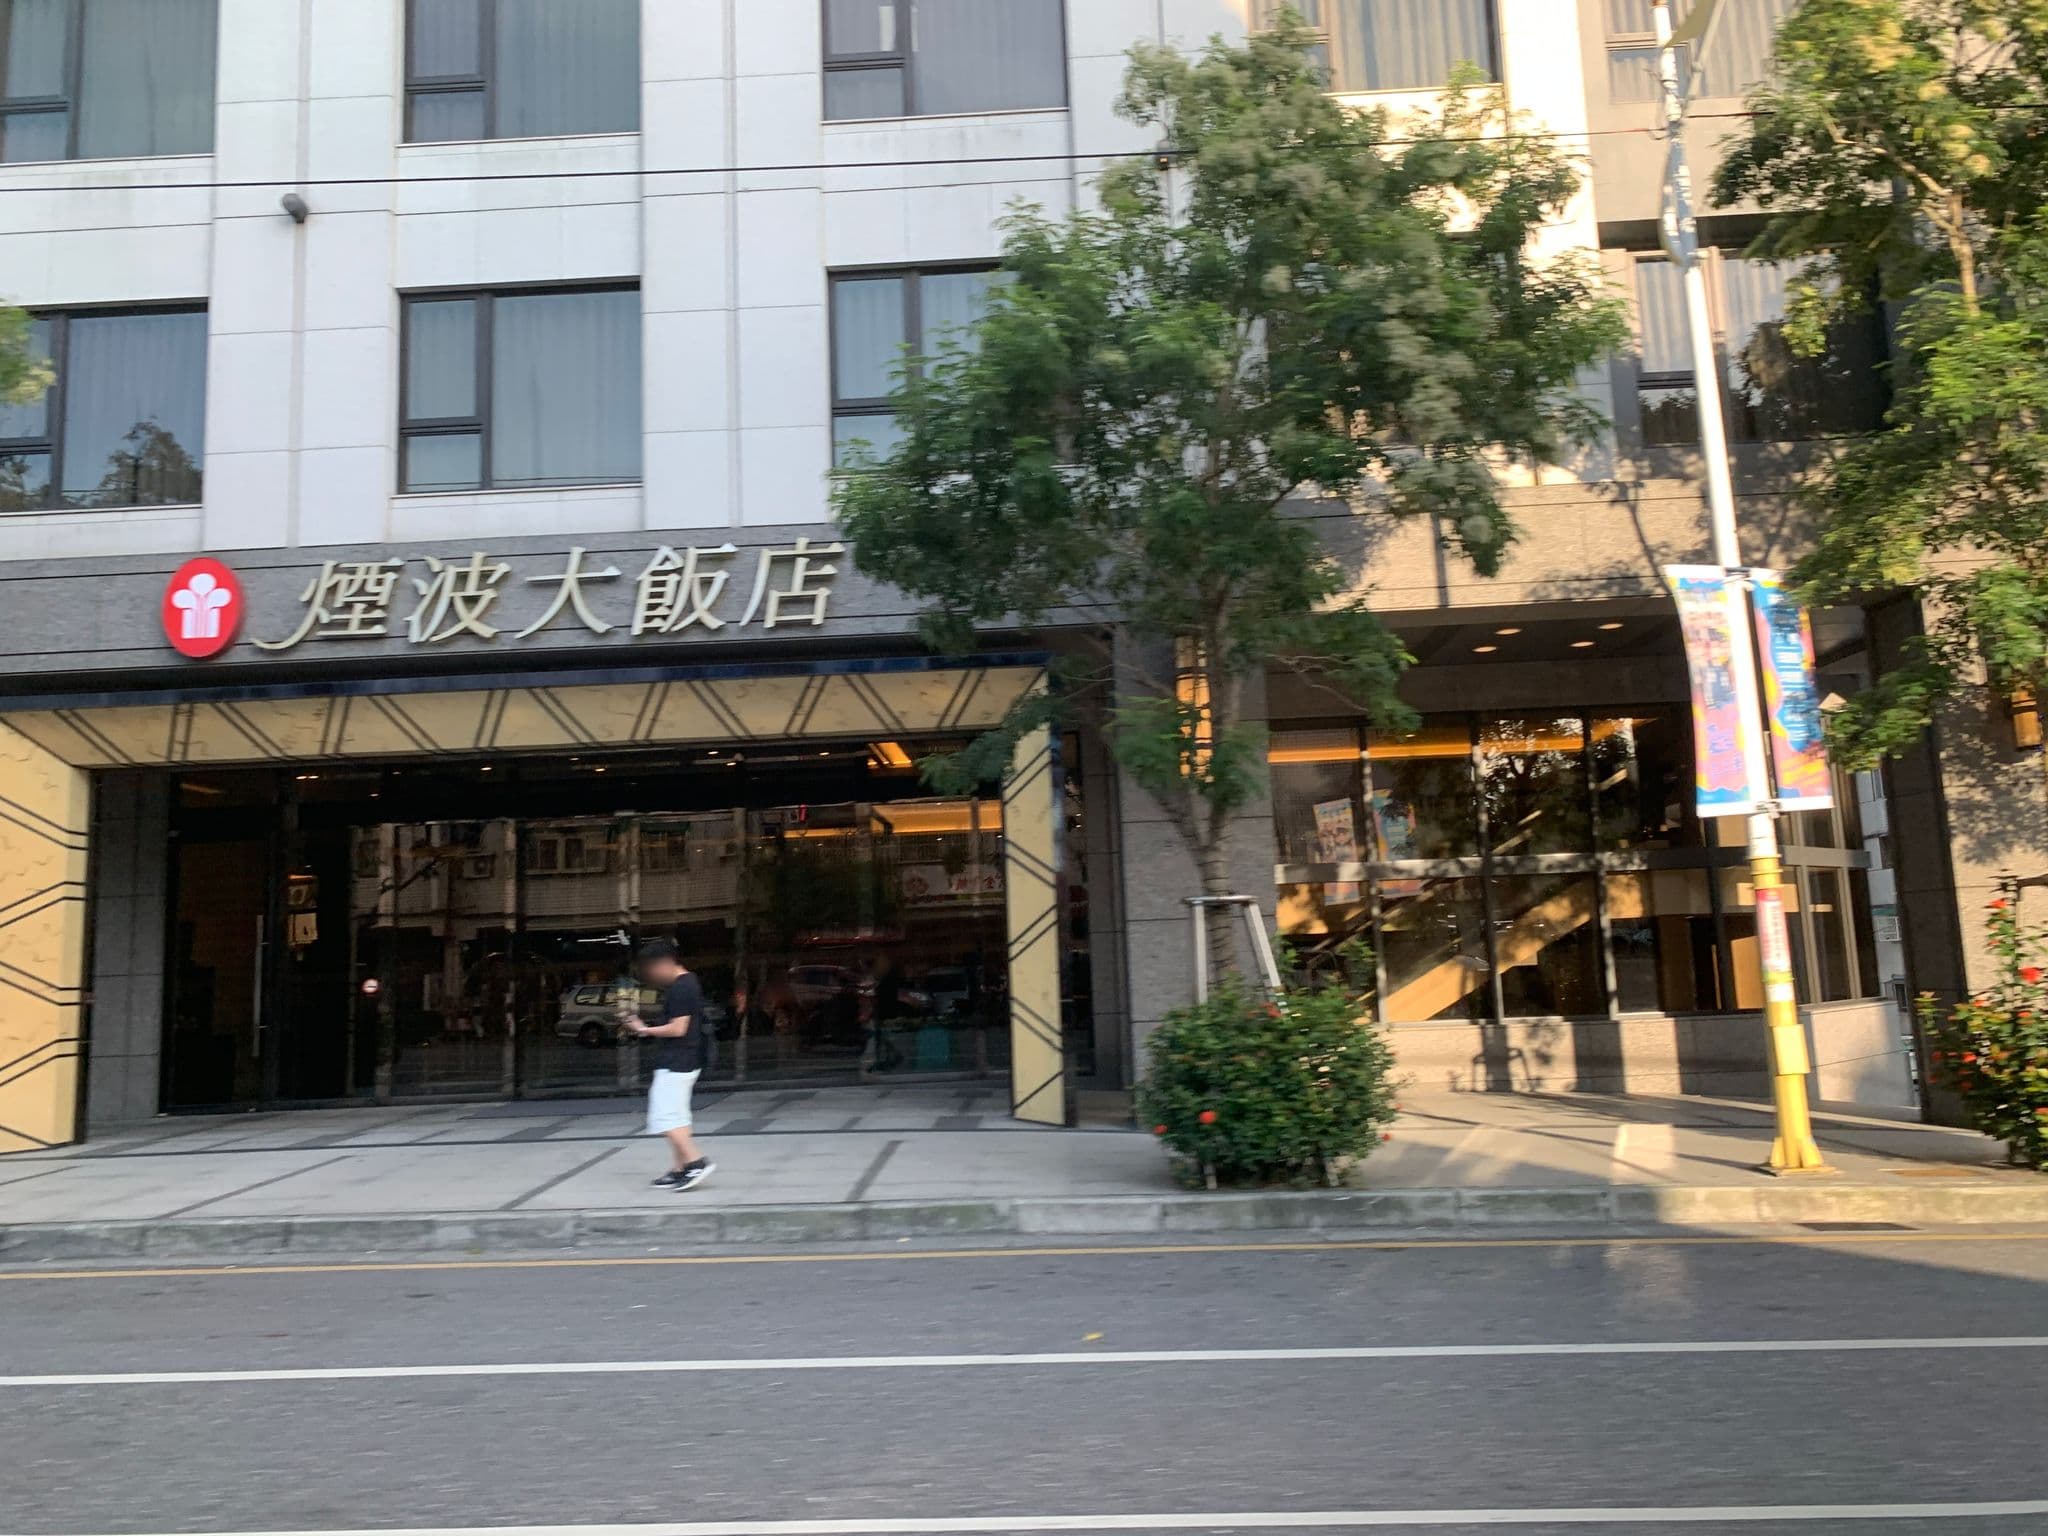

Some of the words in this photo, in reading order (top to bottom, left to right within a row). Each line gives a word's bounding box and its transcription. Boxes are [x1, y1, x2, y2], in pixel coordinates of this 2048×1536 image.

[251, 537, 846, 651] 煙波大飯店
